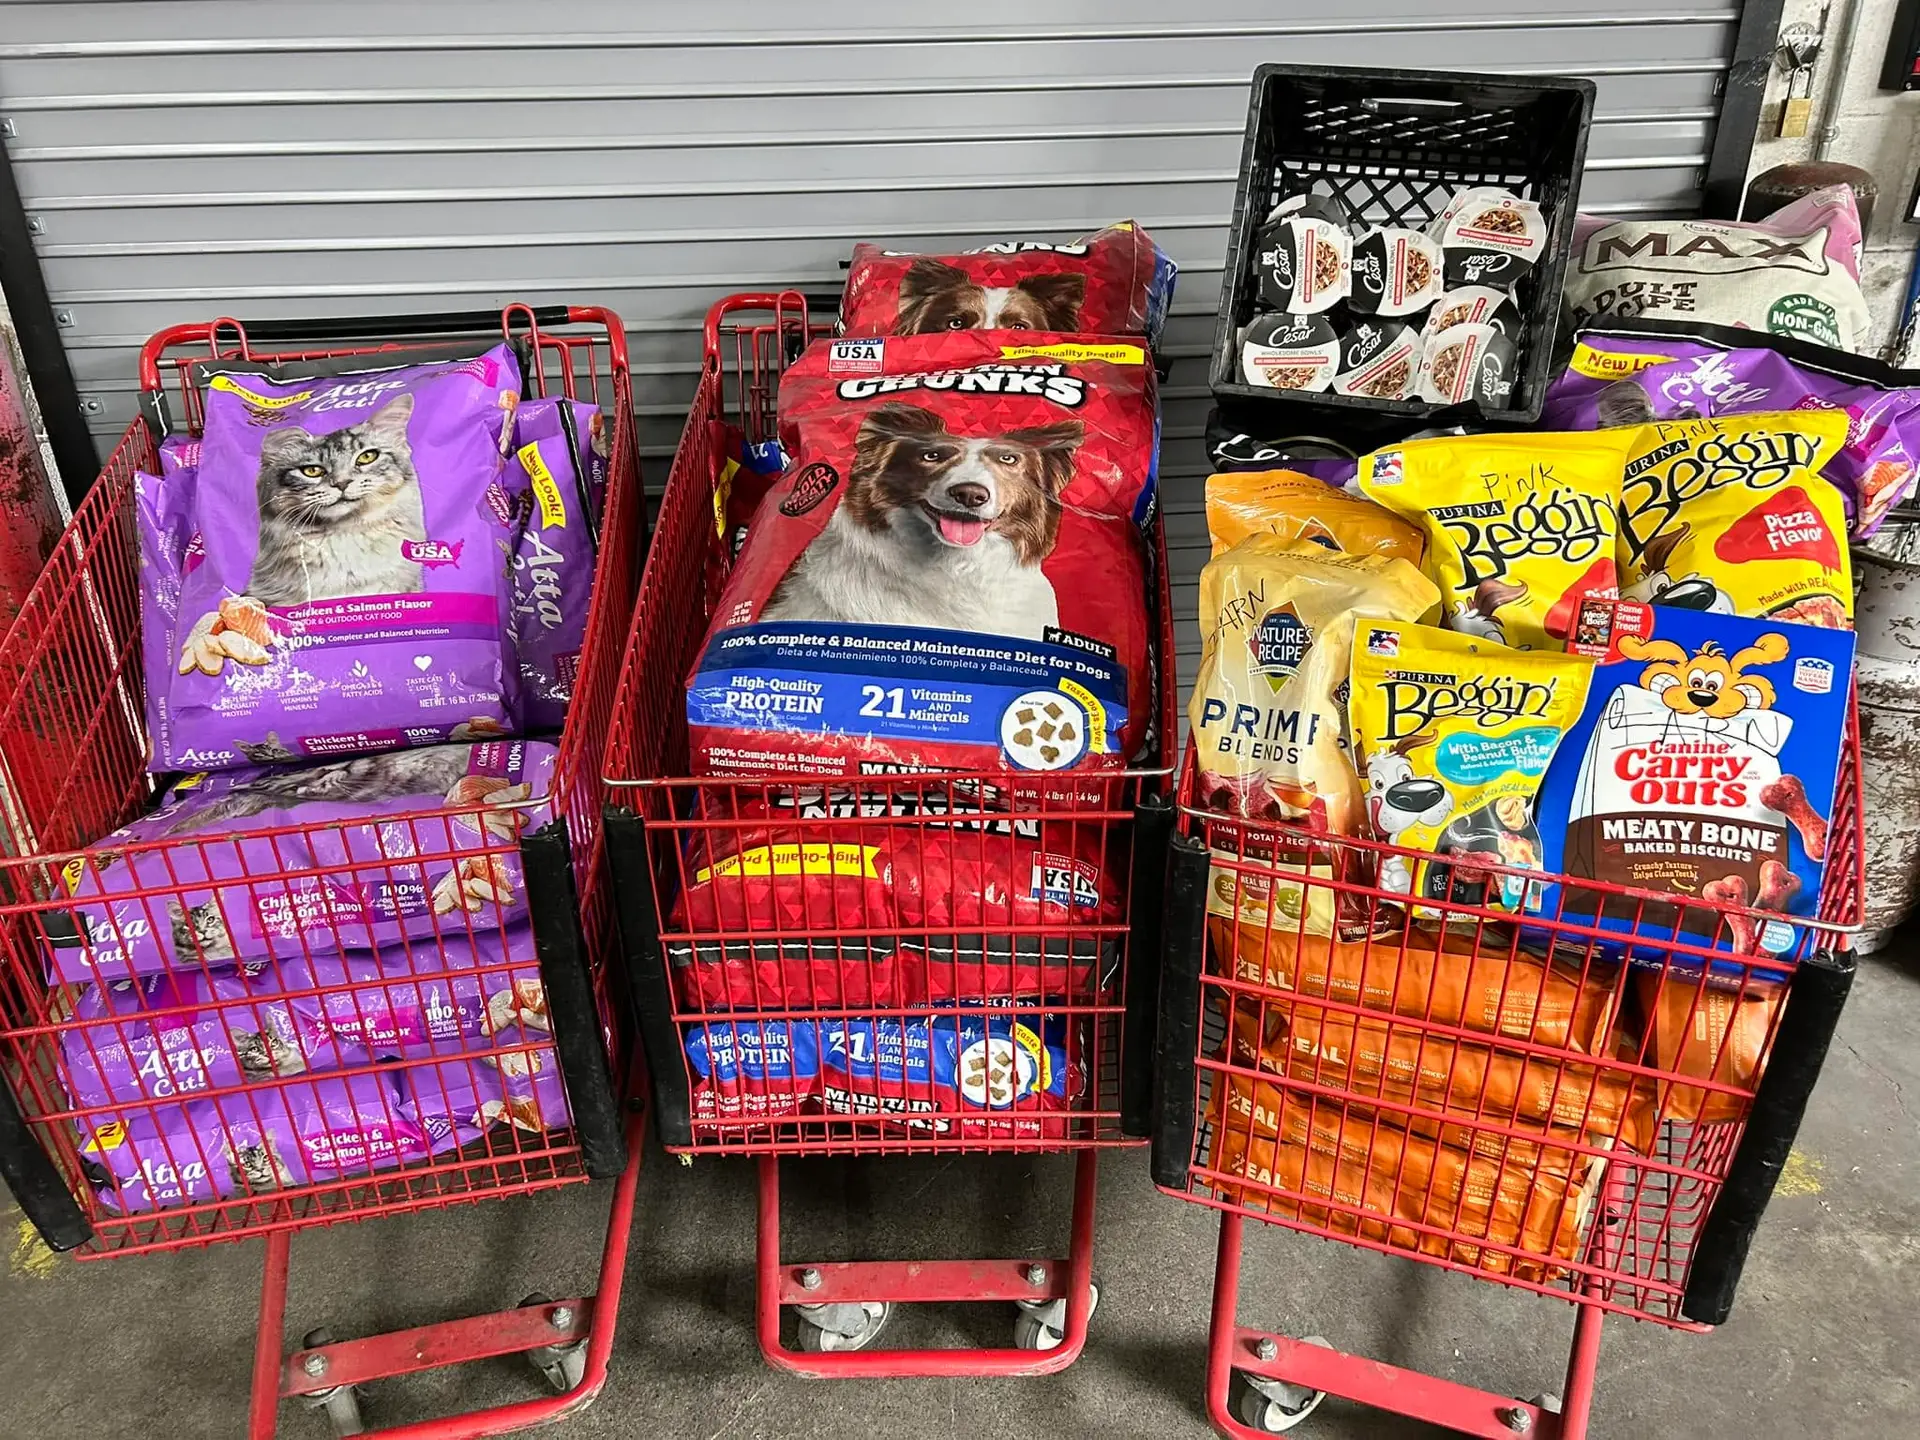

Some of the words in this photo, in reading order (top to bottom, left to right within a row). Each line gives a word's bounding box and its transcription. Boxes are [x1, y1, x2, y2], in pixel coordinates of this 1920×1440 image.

[1594, 232, 1813, 267] MAX
[1363, 251, 1384, 294] Cesar
[1784, 295, 1815, 310] MADE
[1268, 325, 1316, 347] Cesar
[837, 346, 877, 360] USA
[1085, 349, 1126, 359] Protein
[1347, 328, 1383, 368] Cesar
[1588, 351, 1629, 370] New
[300, 380, 407, 410] Atta
[837, 371, 1086, 408] CHUNKS
[313, 390, 383, 412] Cat!
[1626, 439, 1688, 477] URINA
[538, 478, 564, 518] Look!
[1430, 503, 1504, 520] PURINA
[1763, 511, 1817, 531] Pizza
[1766, 527, 1823, 551] Flavor
[410, 545, 453, 560] USA
[521, 530, 565, 630] Atta
[1757, 592, 1782, 607] Made
[1785, 582, 1808, 596] With
[287, 604, 336, 620] Chicken
[335, 603, 345, 614] &
[346, 601, 393, 614] Salmon
[394, 598, 433, 610] Flavor
[326, 613, 364, 625] OUTDOOR
[365, 612, 380, 621] CAT
[380, 610, 403, 620] FOOD
[1616, 612, 1642, 623] Great
[1617, 604, 1644, 615] Some
[1250, 624, 1315, 645] NATURE'S
[1615, 621, 1642, 632] Treat!
[289, 635, 326, 650] 100%
[327, 632, 363, 645] Complete
[363, 631, 379, 641] and
[379, 628, 414, 639] Balanced
[414, 625, 450, 637] Nutrition
[1062, 635, 1112, 658] ADULT
[720, 635, 757, 649] 100%
[758, 634, 826, 649] Complete
[827, 635, 841, 647] &
[842, 636, 911, 651] Balanced
[912, 641, 1012, 662] Maintenance
[1014, 651, 1047, 666] Diet
[1049, 655, 1073, 670] for
[1075, 663, 1112, 681] Dogs
[776, 646, 804, 658] Dieta
[805, 648, 819, 659] de
[820, 650, 898, 664] Mantenimiento
[900, 654, 927, 666] 100%
[929, 656, 979, 672] Completa
[980, 661, 988, 672] y
[988, 661, 1050, 678] Balanceada
[1257, 642, 1302, 662] RECIPE
[730, 675, 823, 695] High-Quality
[1398, 671, 1455, 686] PURINA
[342, 690, 362, 698] FATTY
[362, 688, 383, 697] ACIDS
[725, 691, 825, 715] PROTEIN
[859, 684, 907, 720] 21
[910, 688, 973, 704] Vitamins
[284, 702, 318, 712] MINERALS
[908, 708, 971, 724] Minerals
[928, 702, 952, 713] AND
[1376, 674, 1558, 741] Beggin'
[304, 735, 356, 747] Chicken
[357, 733, 368, 743] &
[403, 727, 440, 737] 100%
[308, 743, 356, 752] Salmon
[358, 738, 397, 748] Flavor
[1218, 736, 1300, 765] BLENDS
[1447, 742, 1480, 756] With
[1480, 739, 1523, 752] Bacon
[1524, 734, 1537, 745] &
[1462, 750, 1509, 763] Peanut
[1510, 744, 1552, 757] Butter
[1649, 739, 1729, 755] Canine
[175, 748, 235, 766] Atta
[507, 743, 522, 773] 100%
[709, 747, 737, 758] 100%
[737, 749, 785, 763] Complete
[787, 752, 796, 763] &
[797, 753, 846, 766] Balanced
[709, 757, 775, 771] Maintenance
[777, 761, 798, 772] Diet
[799, 764, 815, 773] for
[816, 766, 844, 777] Dogs
[1613, 749, 1752, 782] Carry
[1025, 789, 1039, 799] Wt.
[1051, 790, 1064, 800] lbs
[1086, 792, 1100, 803] kg)
[1216, 823, 1238, 836] LAMB
[1601, 818, 1698, 842] MEATY
[1700, 823, 1782, 853] BONE
[1623, 842, 1677, 856] BAKED
[1679, 844, 1753, 863] BISCUITS
[1632, 870, 1654, 880] Helps
[1654, 870, 1674, 879] Clean
[1633, 863, 1664, 872] Crunchy
[1043, 868, 1092, 894] USA
[1236, 958, 1295, 991] ZEAL
[828, 1031, 868, 1063] 21
[1016, 1027, 1038, 1050] Taste
[130, 1049, 217, 1086] Atta
[371, 1128, 383, 1140] &
[122, 1158, 208, 1189] Atta
